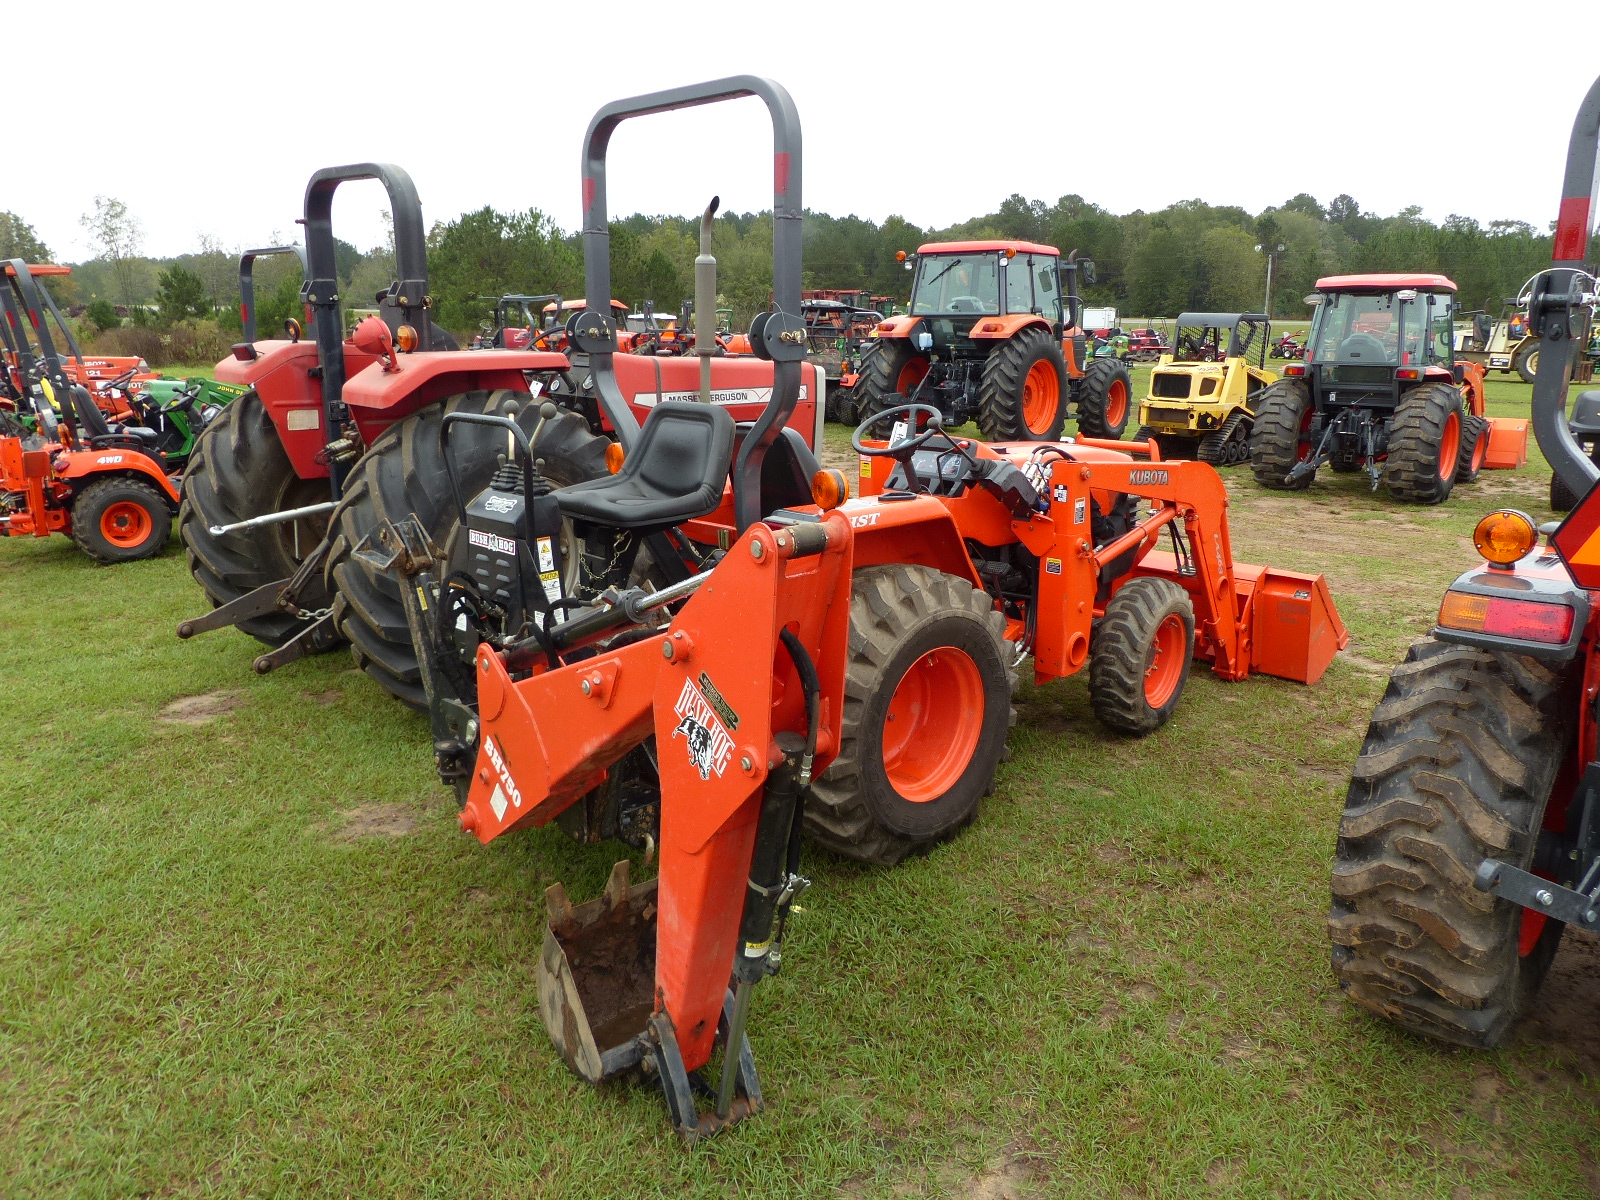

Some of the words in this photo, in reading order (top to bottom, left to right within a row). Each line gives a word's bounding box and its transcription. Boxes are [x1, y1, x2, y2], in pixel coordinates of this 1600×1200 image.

[217, 385, 235, 394] JOHN
[709, 392, 749, 402] ERGUSON
[96, 455, 123, 464] 4WD
[1128, 469, 1169, 485] KUBOTA
[471, 532, 489, 546] BUSH
[498, 539, 514, 552] HOG
[675, 679, 712, 729] BUSH
[709, 720, 734, 776] HOG
[484, 735, 522, 808] BH750
